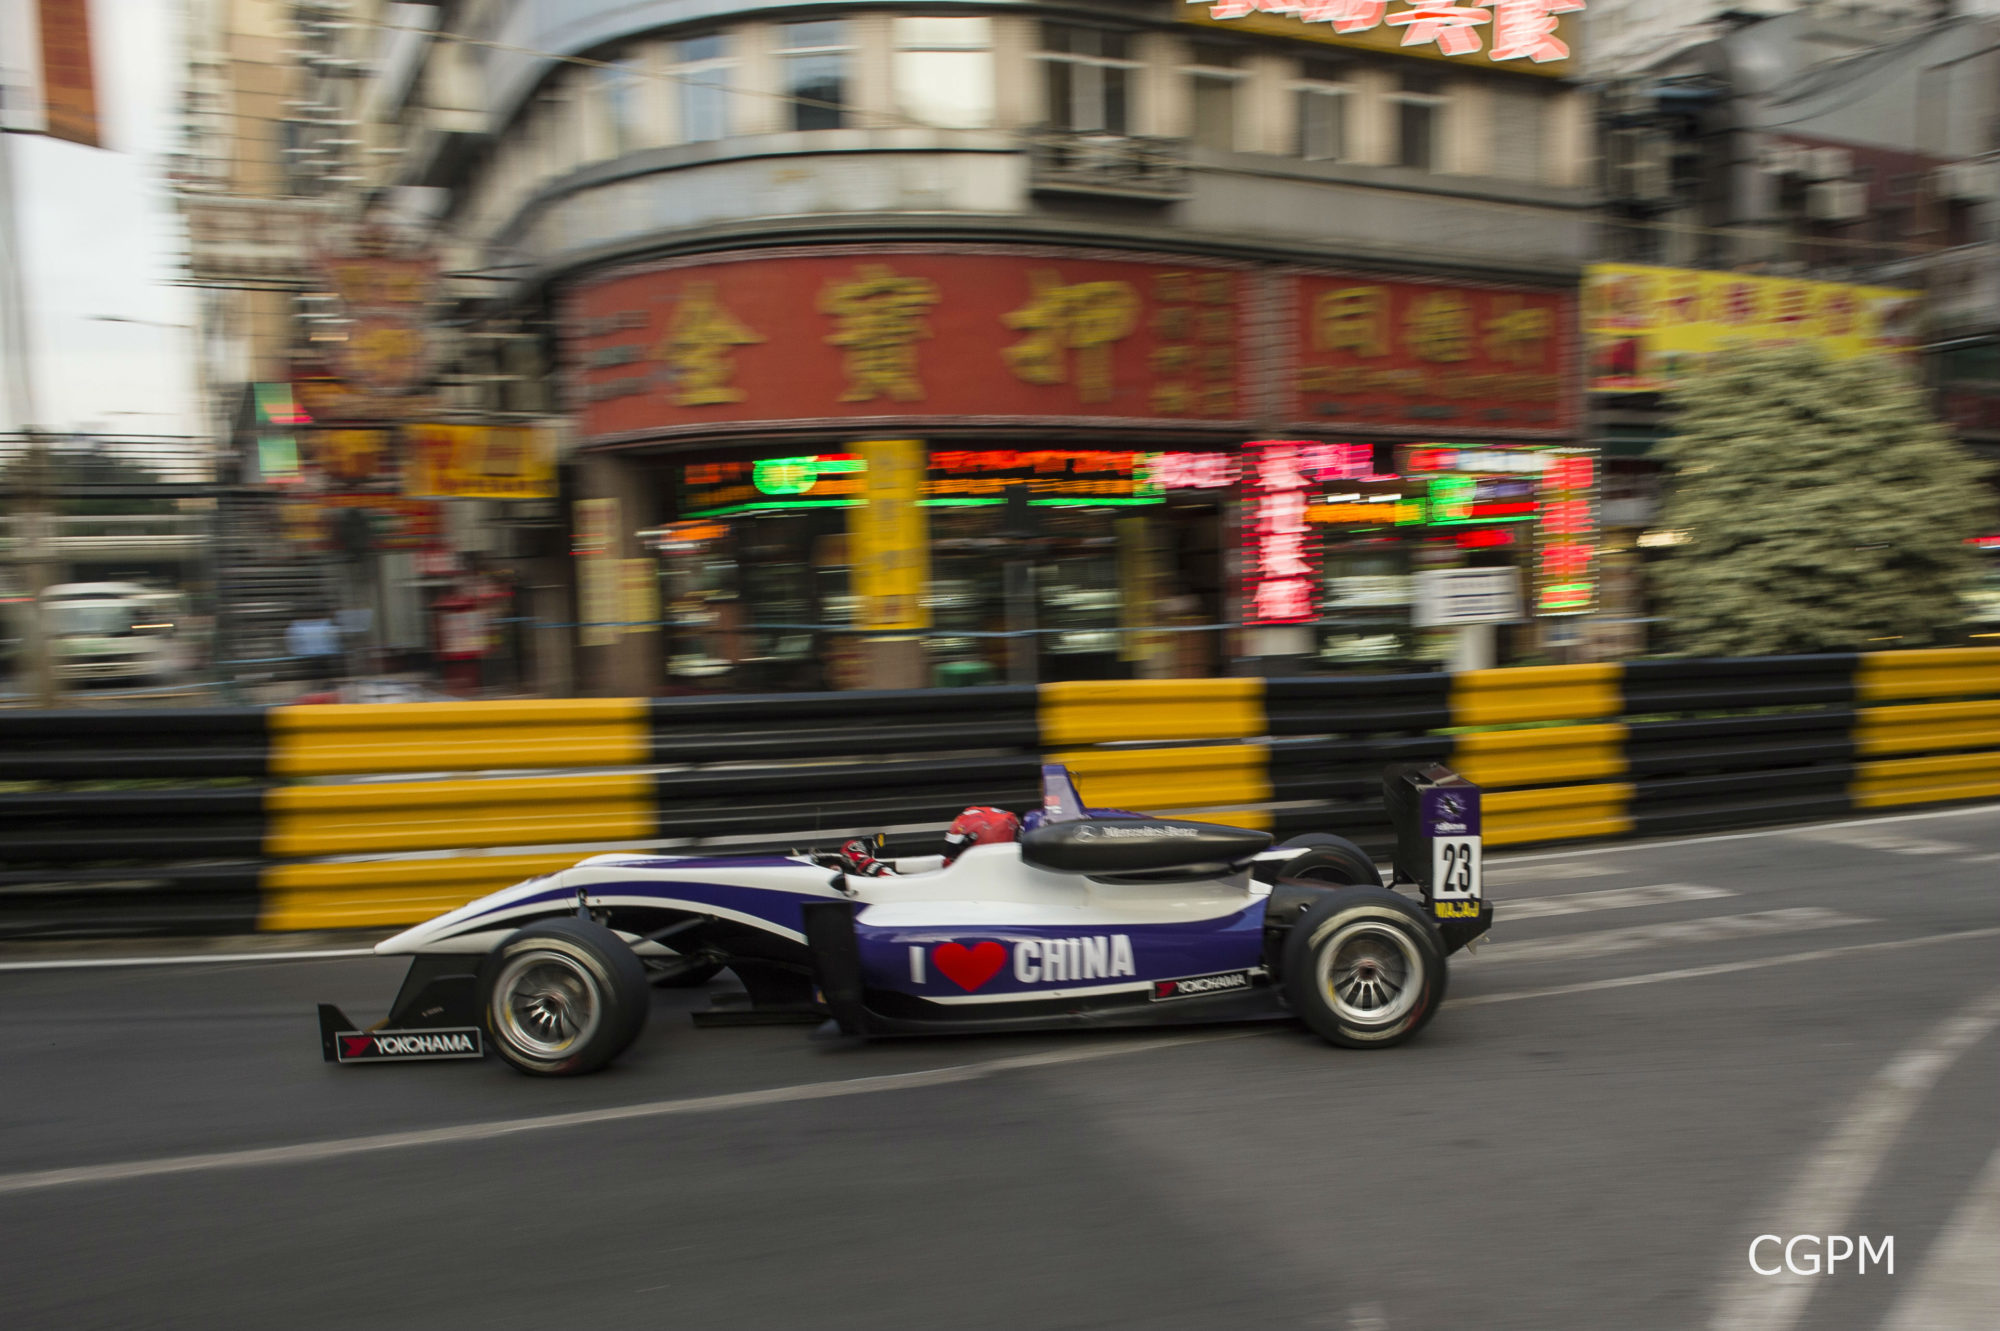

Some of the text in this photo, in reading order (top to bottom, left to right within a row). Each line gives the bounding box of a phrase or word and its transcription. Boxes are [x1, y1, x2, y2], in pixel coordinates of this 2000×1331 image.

[1443, 843, 1471, 892] 23
[908, 934, 1136, 984] I CHINA
[1176, 974, 1246, 993] YOKOHAMA
[373, 1033, 475, 1055] YOKOHAMA
